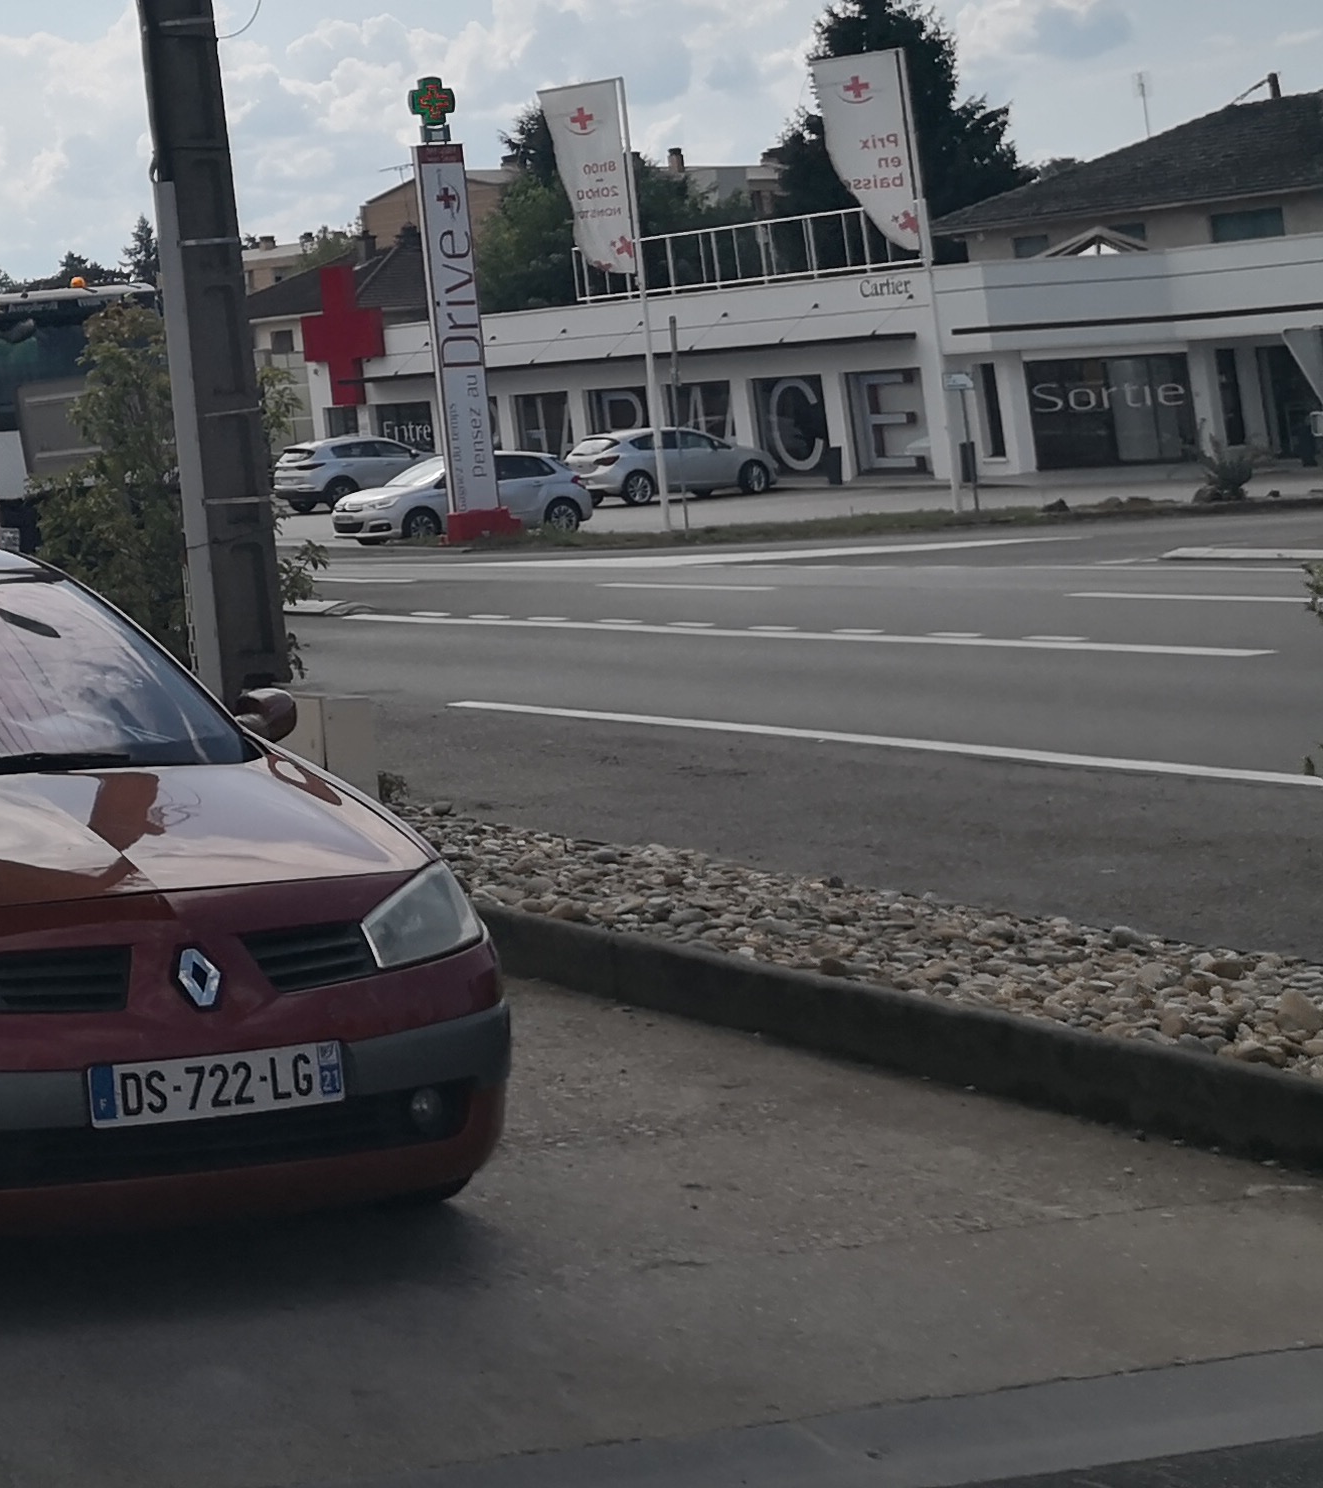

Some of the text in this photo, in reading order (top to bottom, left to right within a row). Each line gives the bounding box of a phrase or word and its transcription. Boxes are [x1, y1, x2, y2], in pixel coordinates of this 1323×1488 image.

[859, 276, 913, 299] Cartier
[435, 229, 488, 478] pensez au Drive
[1032, 380, 1186, 413] Sortie
[119, 1052, 315, 1117] DS-722-LG
[320, 1069, 341, 1092] 21
